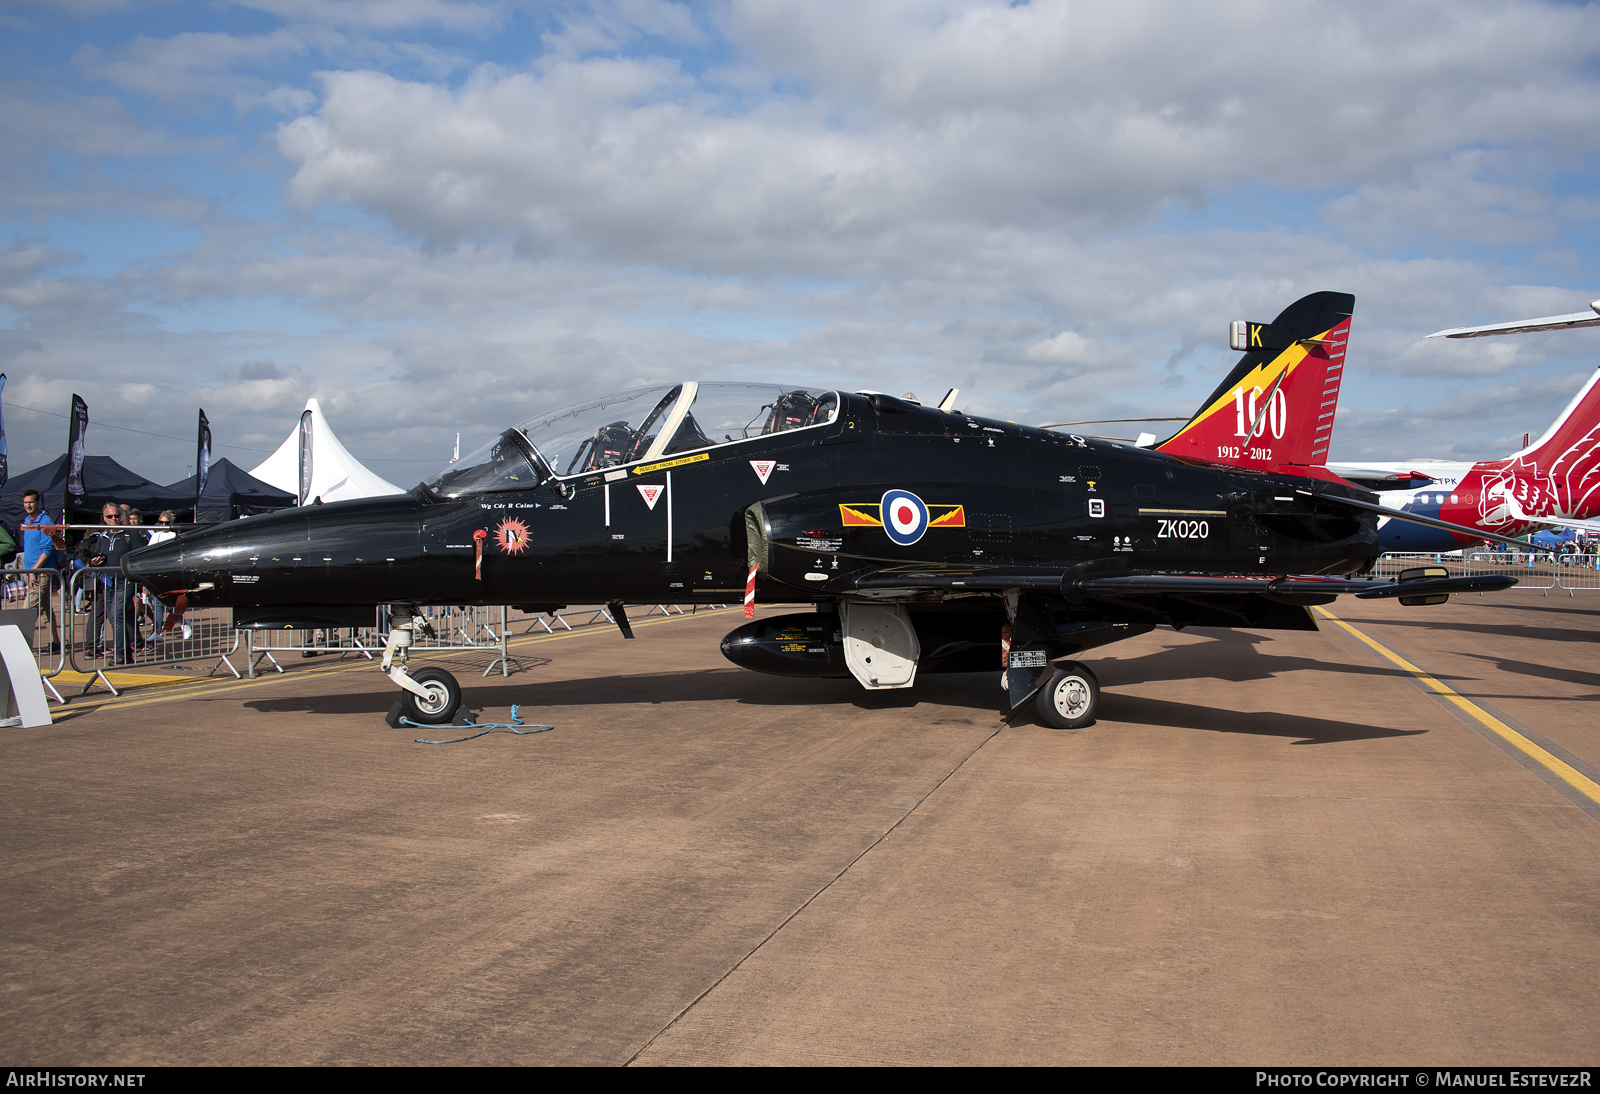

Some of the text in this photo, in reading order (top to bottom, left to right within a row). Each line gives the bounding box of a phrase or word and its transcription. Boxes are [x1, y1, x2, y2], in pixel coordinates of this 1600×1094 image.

[1251, 324, 1263, 347] K
[1231, 385, 1287, 440] 100
[848, 421, 855, 429] 2
[1217, 445, 1240, 459] 1912
[1250, 447, 1272, 461] 2012
[639, 464, 657, 472] RESCUE
[675, 457, 691, 465] EITHER
[480, 502, 492, 510] Wg
[1157, 519, 1210, 539] ZK020
